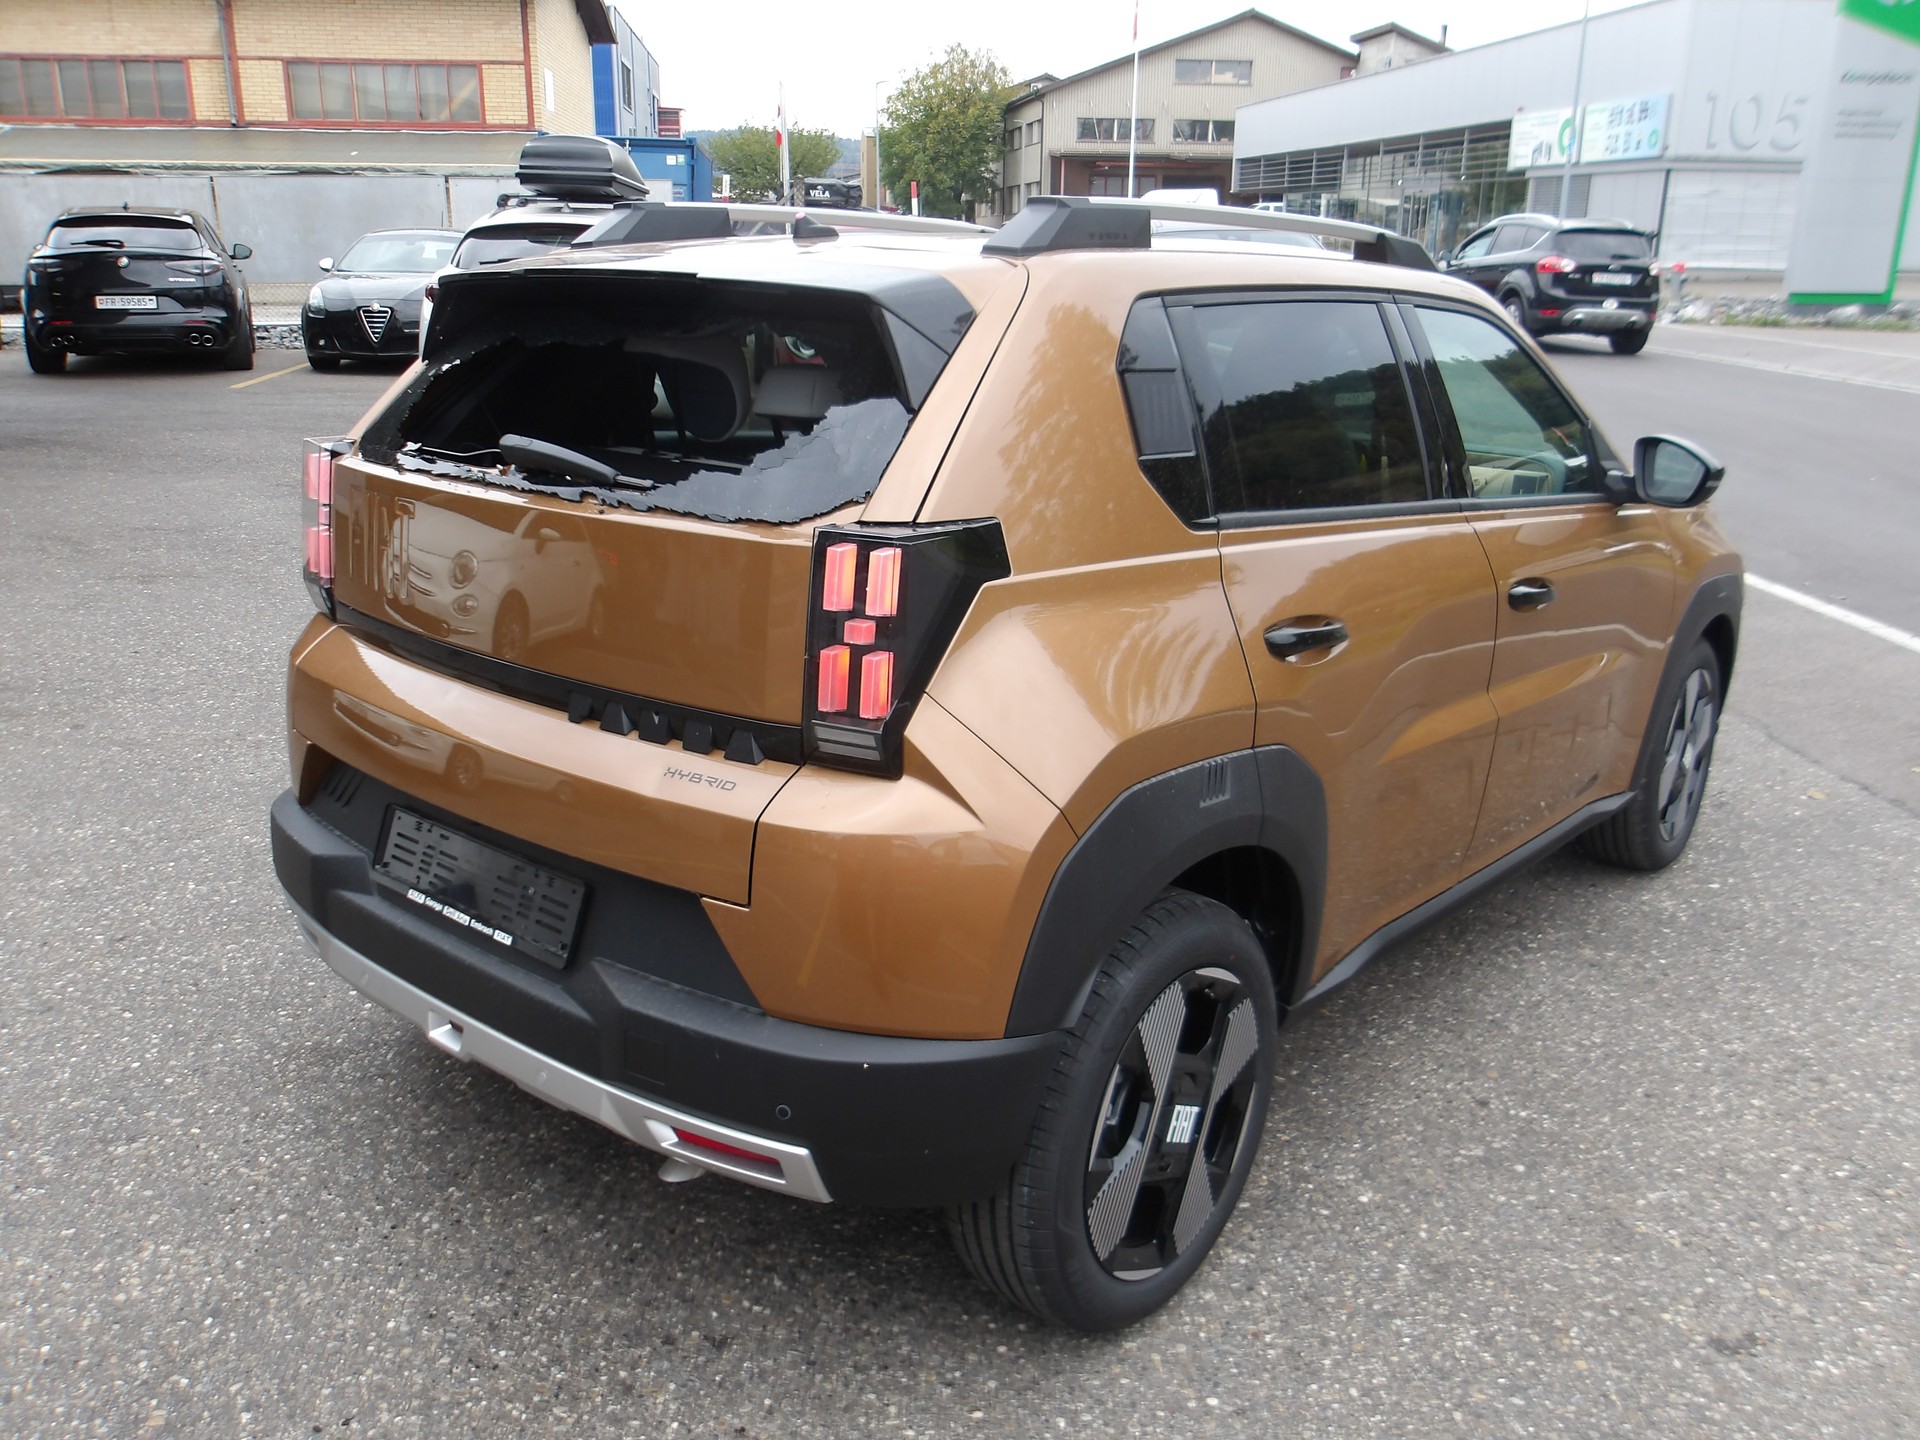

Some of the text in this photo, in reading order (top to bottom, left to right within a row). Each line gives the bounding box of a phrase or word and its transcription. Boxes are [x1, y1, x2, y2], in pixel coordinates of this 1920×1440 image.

[1706, 90, 1811, 153] 105
[809, 189, 831, 198] VELA
[121, 297, 148, 307] 59585
[663, 766, 737, 791] HYBRID
[1166, 1104, 1201, 1144] FIAT
